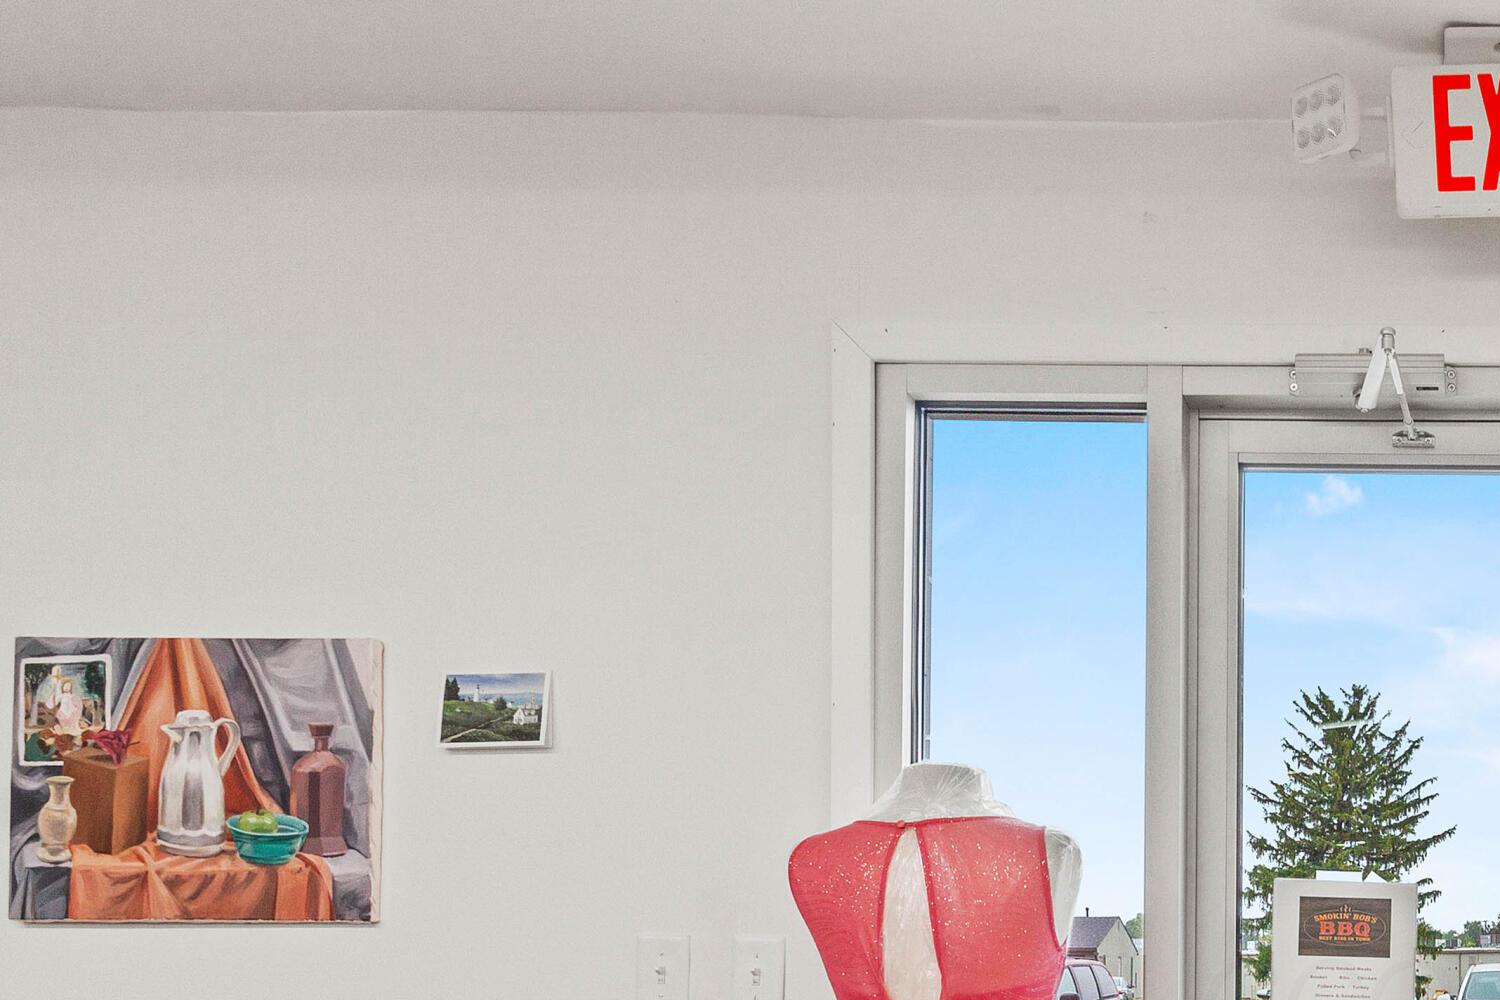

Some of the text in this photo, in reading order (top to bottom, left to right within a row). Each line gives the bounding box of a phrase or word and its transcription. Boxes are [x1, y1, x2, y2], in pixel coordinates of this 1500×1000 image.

[1313, 912, 1377, 923] SMOKIN' BOB'S
[1319, 921, 1371, 936] BBQ
